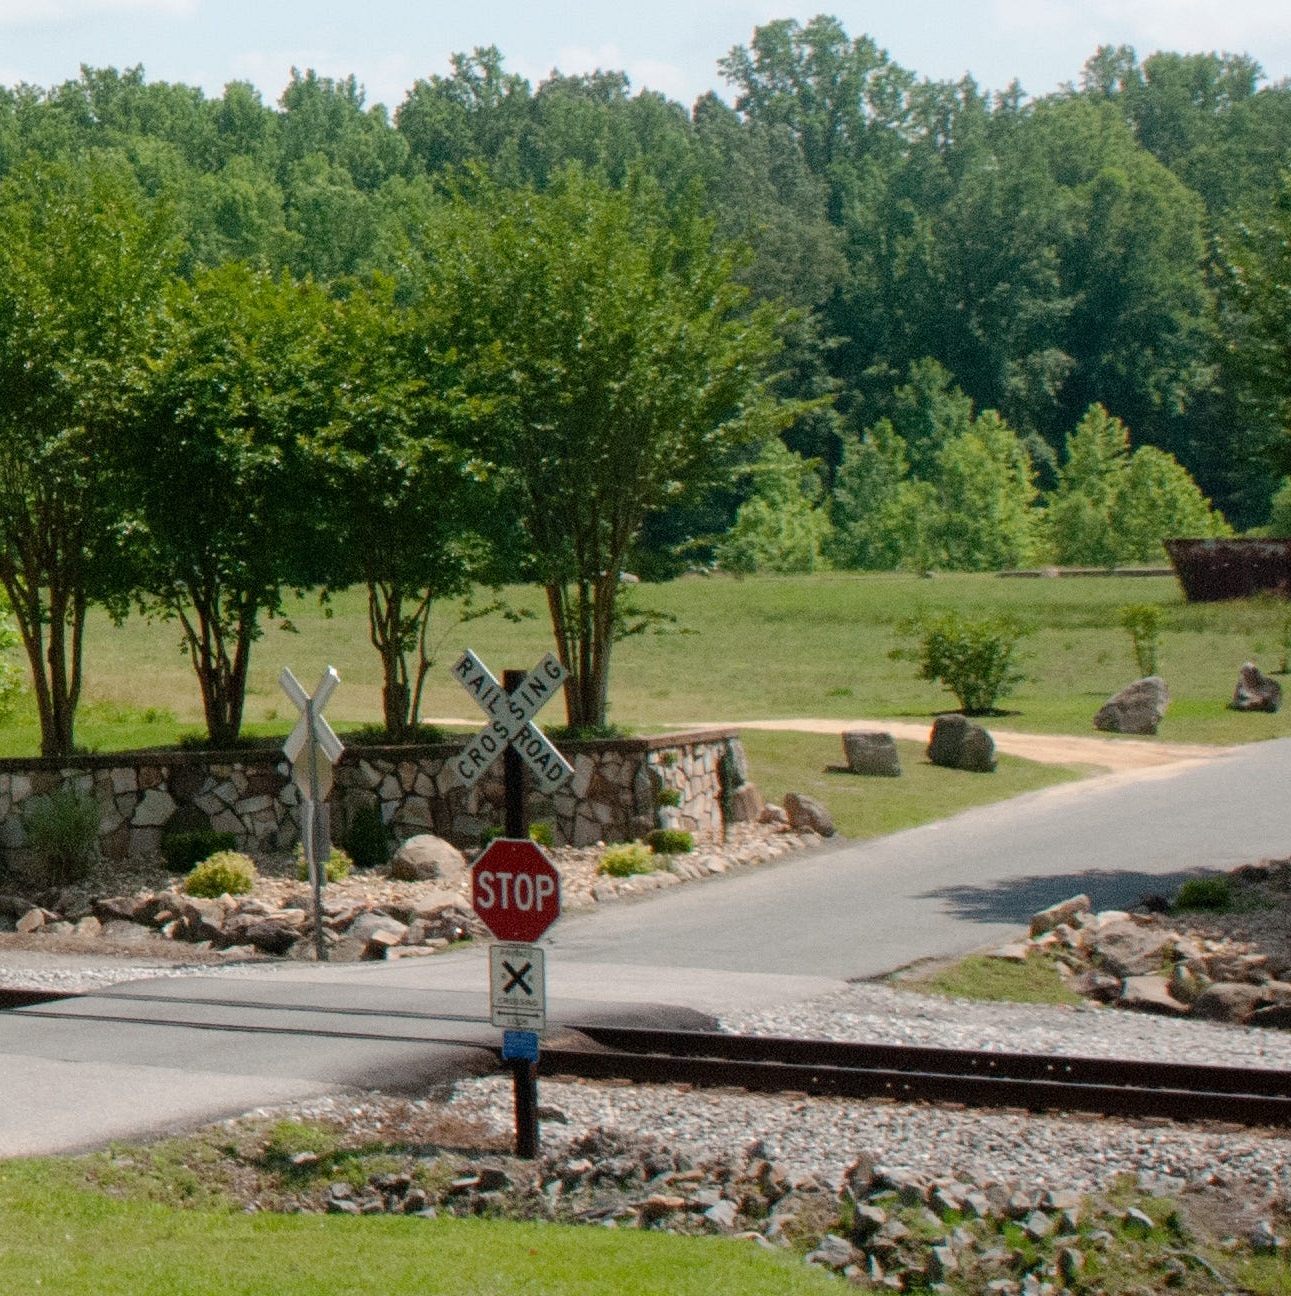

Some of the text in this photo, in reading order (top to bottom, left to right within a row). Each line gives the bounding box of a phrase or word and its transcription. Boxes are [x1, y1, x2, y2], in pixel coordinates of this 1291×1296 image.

[455, 655, 563, 782] RAIL ROAD
[458, 660, 561, 779] CROSSING
[477, 870, 555, 912] STOP
